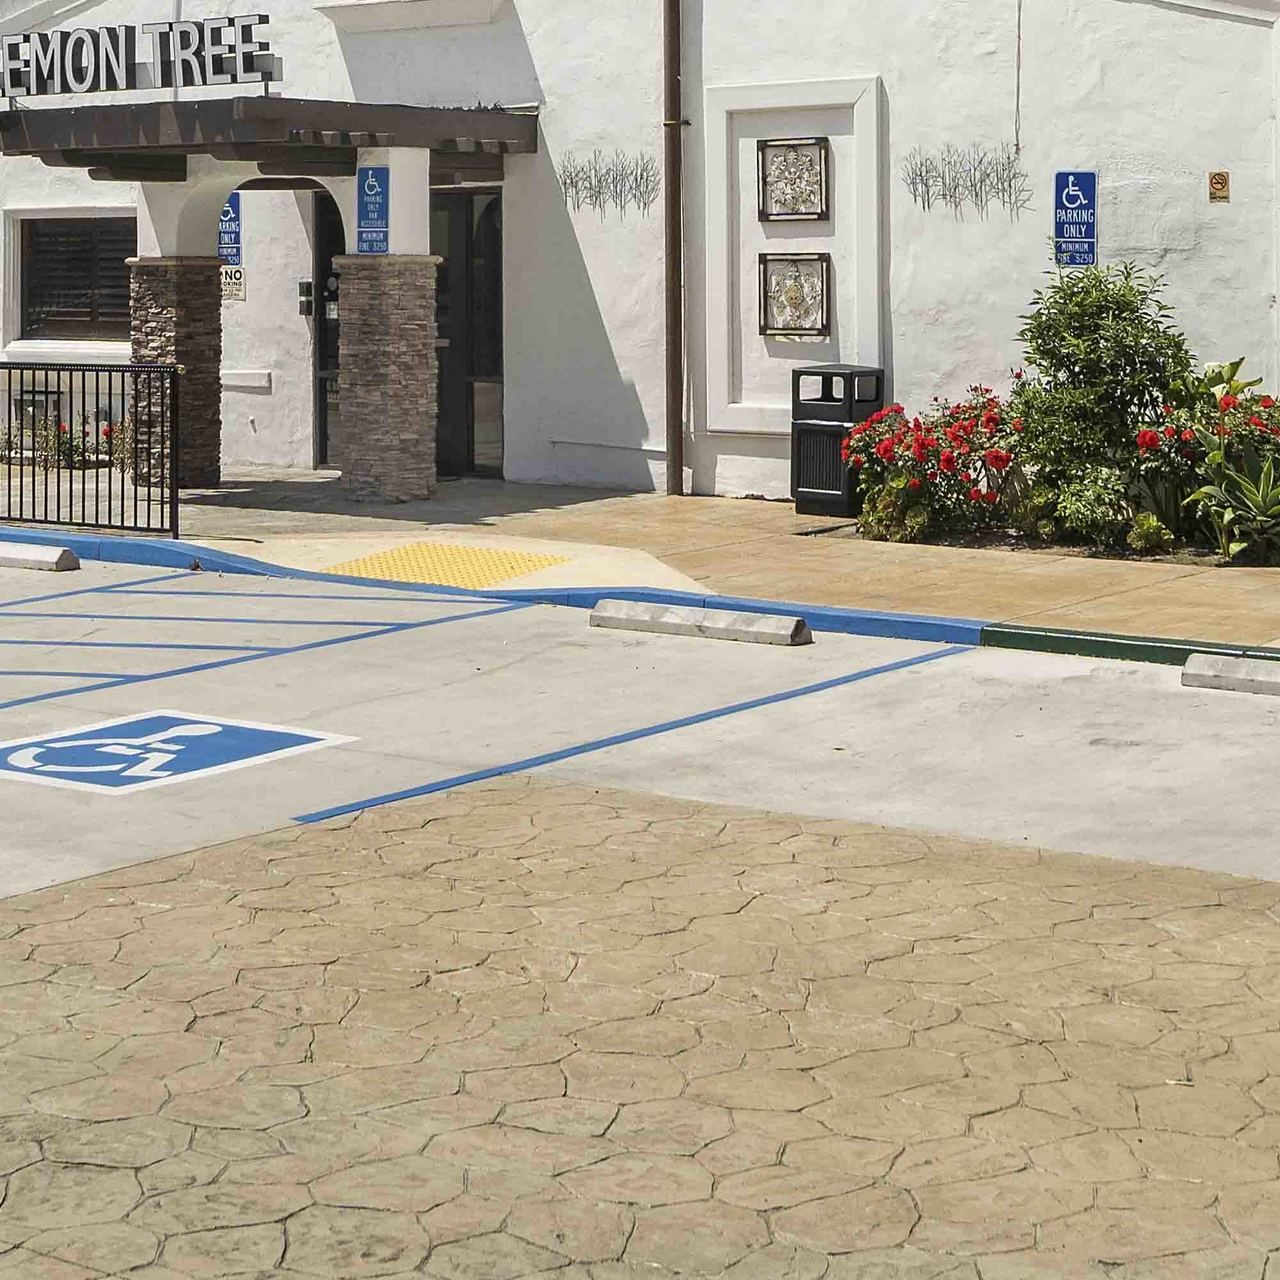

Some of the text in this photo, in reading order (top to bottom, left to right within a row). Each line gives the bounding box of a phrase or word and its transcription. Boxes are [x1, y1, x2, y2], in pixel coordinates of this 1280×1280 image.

[142, 14, 270, 89] TREE
[1056, 209, 1094, 223] PARKING
[219, 221, 239, 232] ARKING
[1063, 224, 1086, 237] ONLY
[220, 233, 235, 244] ONLY
[1062, 242, 1088, 252] MINIMUM
[1075, 253, 1093, 263] $250
[224, 269, 243, 281] NO
